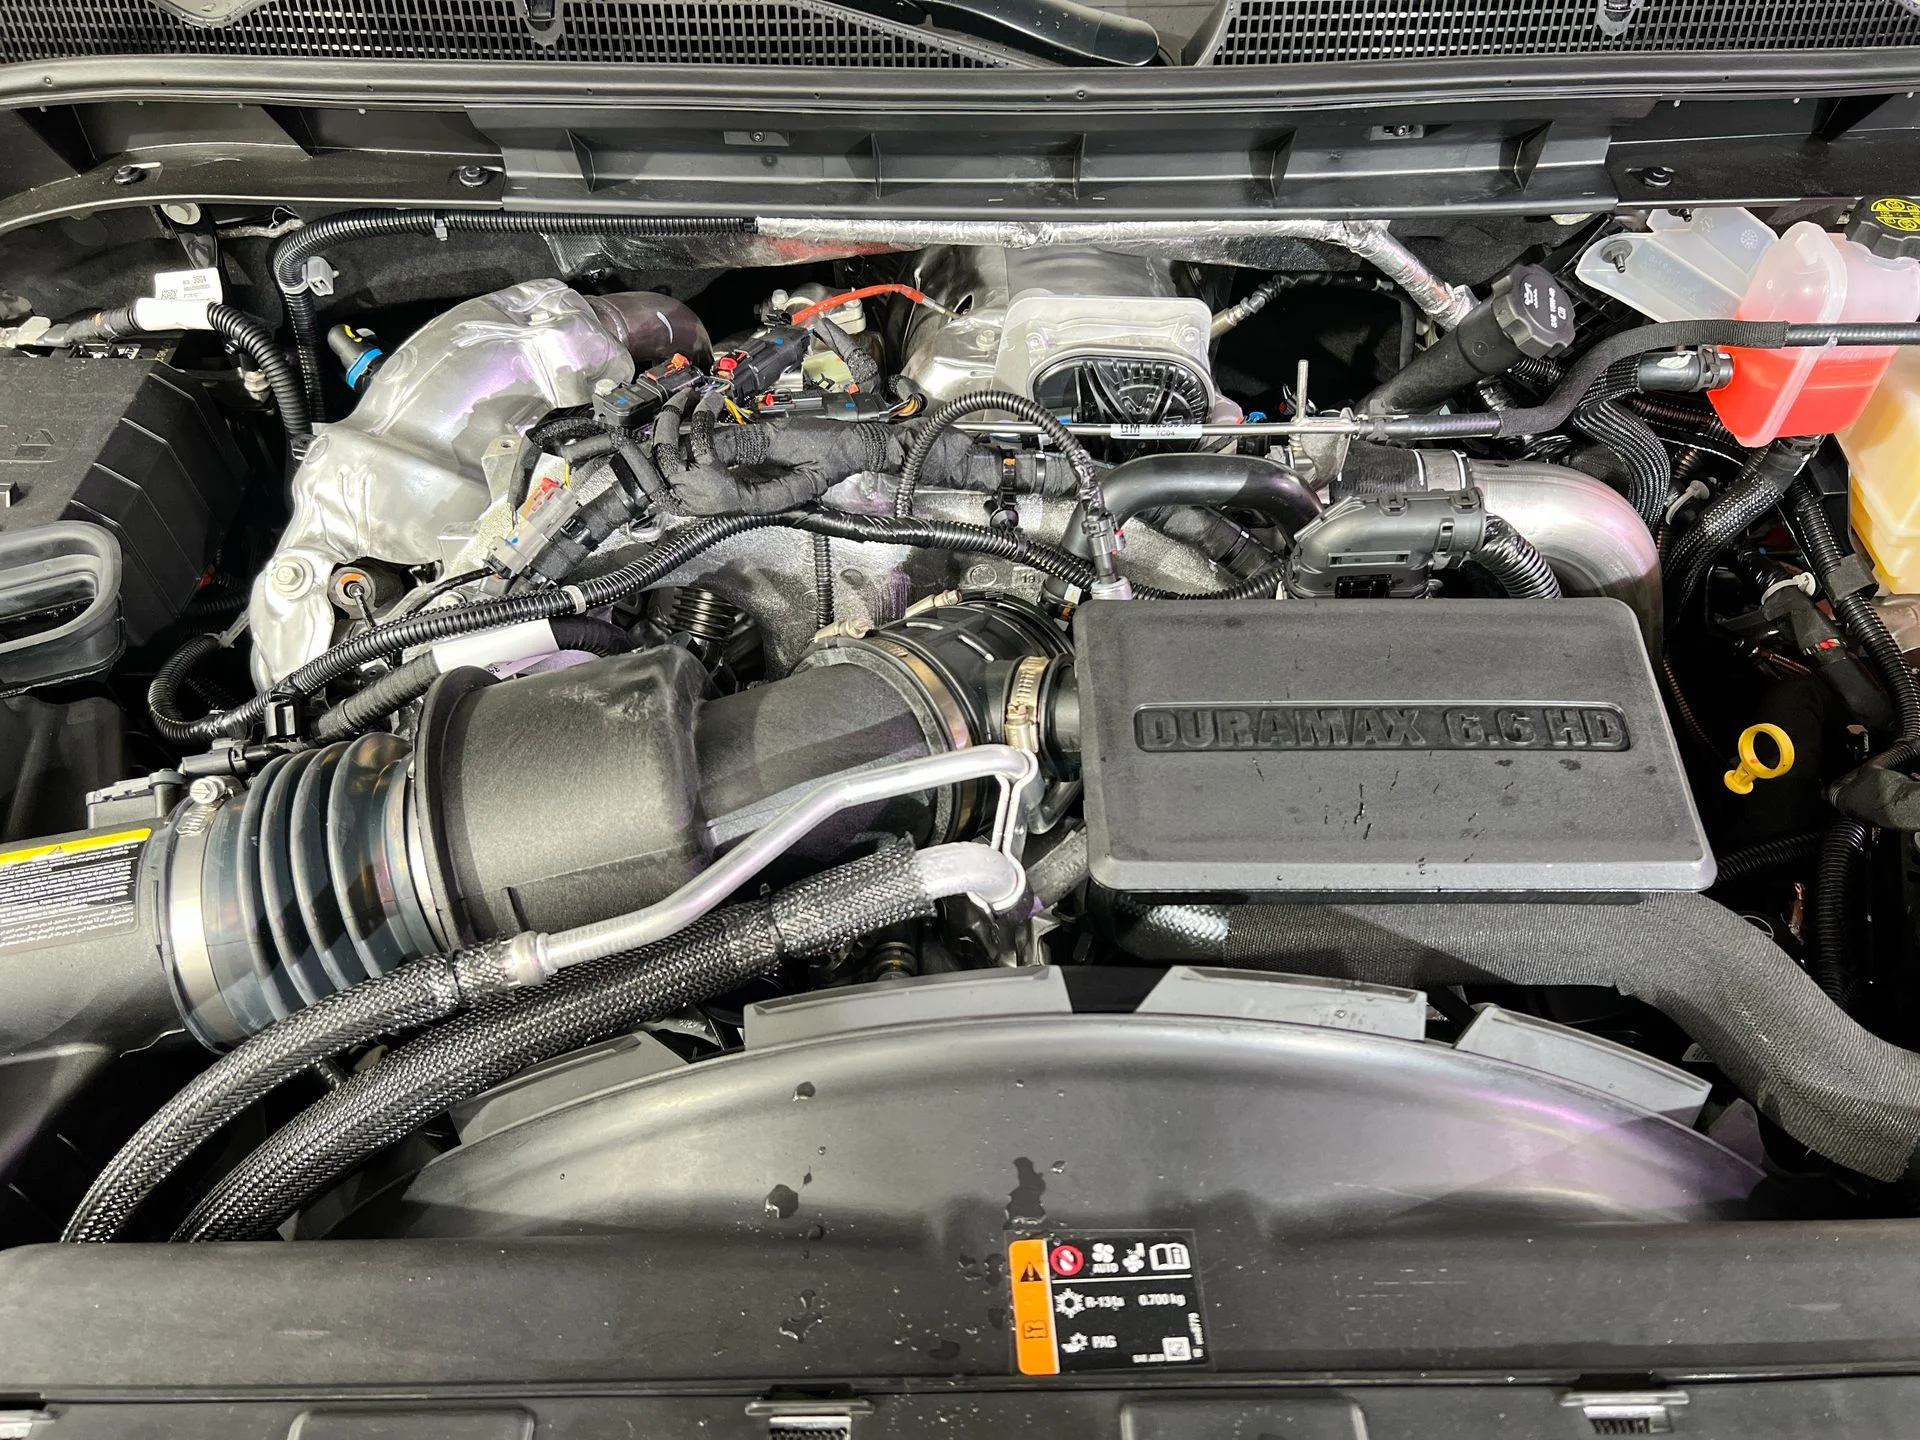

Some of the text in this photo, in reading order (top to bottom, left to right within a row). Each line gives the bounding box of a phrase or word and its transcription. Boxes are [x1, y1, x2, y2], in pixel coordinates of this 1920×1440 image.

[1140, 708, 1626, 748] DURAMAX 6.6 HD
[1092, 1263, 1119, 1273] AUTO
[1138, 1294, 1168, 1307] 0.700
[1169, 1293, 1187, 1307] kg
[1092, 1335, 1117, 1349] PAG
